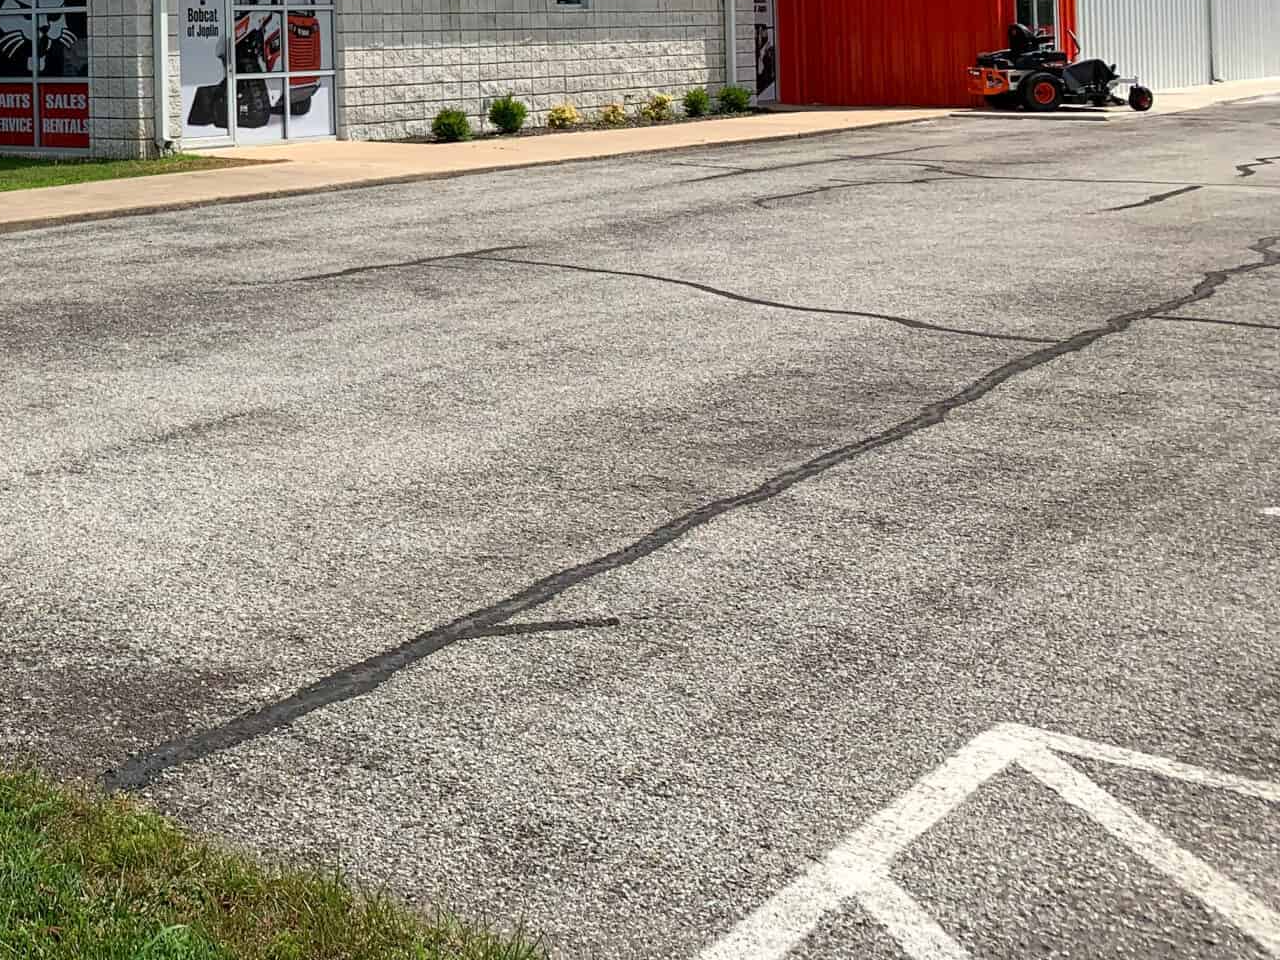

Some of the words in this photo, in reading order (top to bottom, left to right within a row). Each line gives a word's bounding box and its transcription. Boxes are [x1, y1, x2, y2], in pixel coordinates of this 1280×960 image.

[187, 7, 218, 23] Bobcat
[187, 24, 195, 37] of
[196, 23, 219, 39] Joplin
[45, 93, 86, 109] SALES
[42, 118, 89, 134] RENTALS
